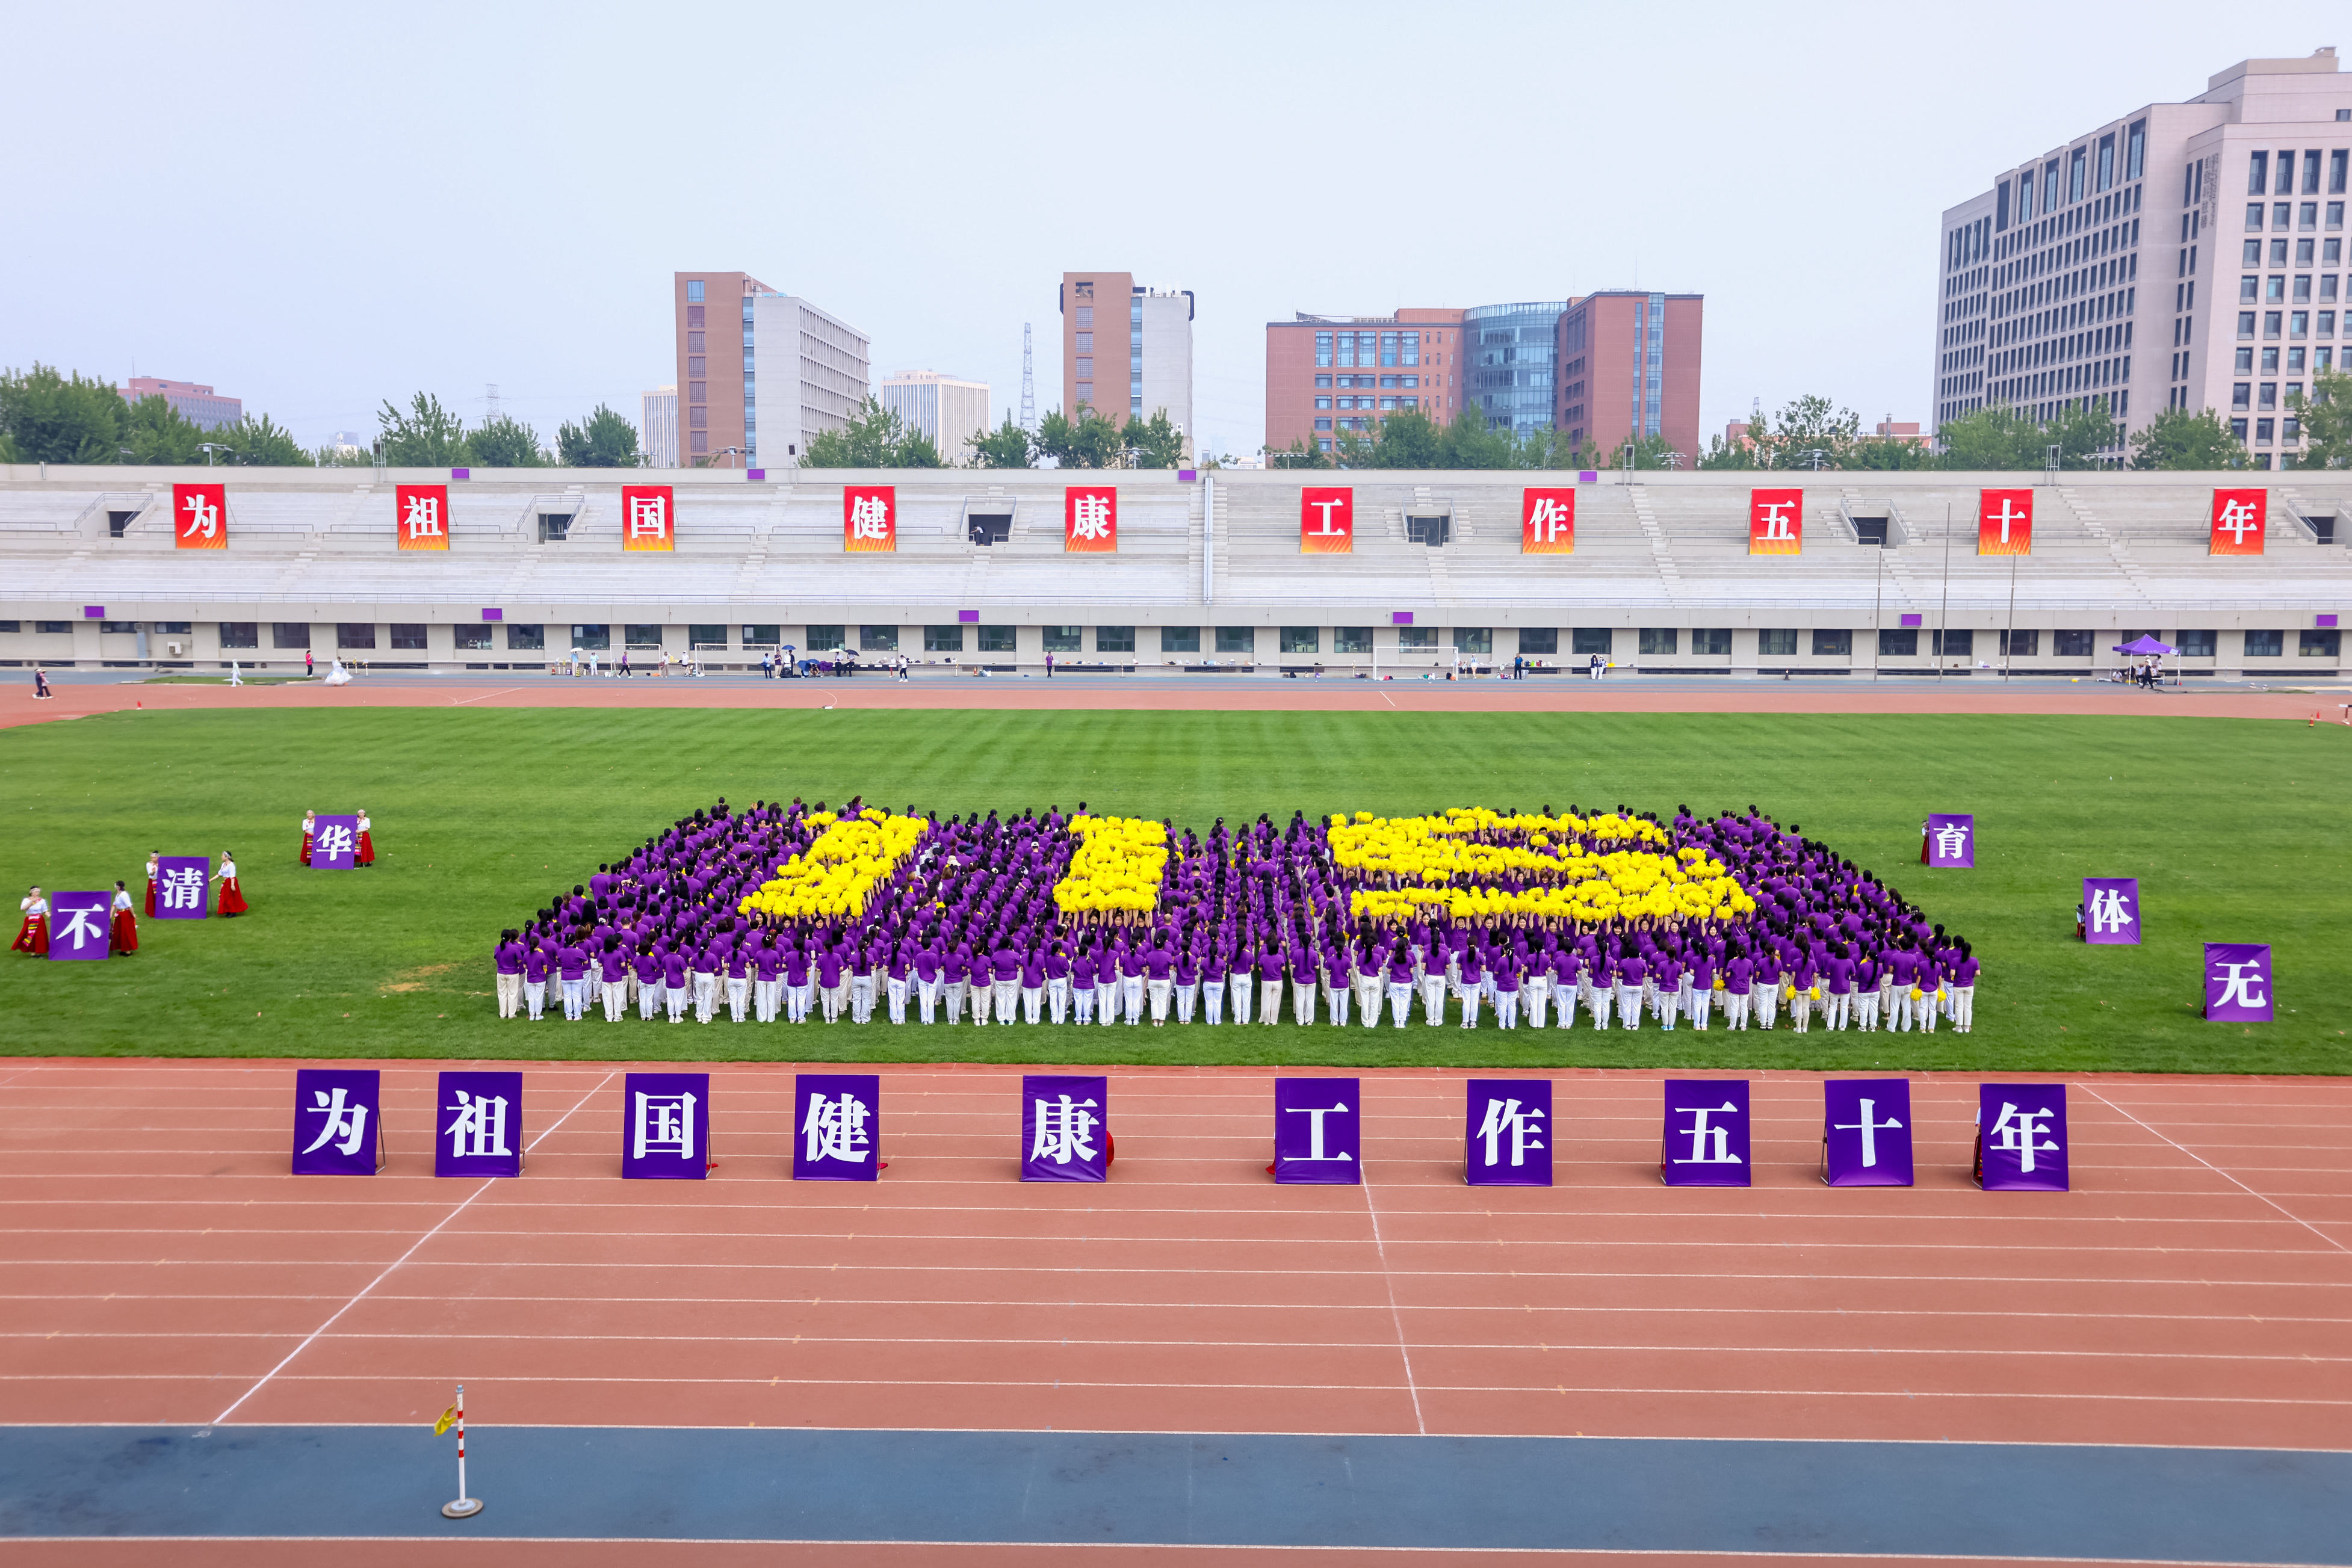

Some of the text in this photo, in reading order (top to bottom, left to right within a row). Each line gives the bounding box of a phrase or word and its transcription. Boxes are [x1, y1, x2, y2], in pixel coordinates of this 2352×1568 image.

[182, 494, 218, 539] 为
[403, 495, 443, 540] 祖
[630, 495, 666, 539] 国
[850, 496, 888, 540] 健
[1071, 495, 1111, 540] 康
[1307, 498, 1346, 536] 工
[1529, 498, 1568, 543] 作
[1756, 500, 1796, 540] 五
[1987, 499, 2026, 544] 十
[2217, 499, 2258, 545] 年
[316, 824, 352, 861] 华
[1933, 823, 1969, 859] 育
[162, 867, 203, 909] 清
[55, 903, 105, 950] 不
[2088, 889, 2134, 933] 体
[2212, 959, 2267, 1008] 无
[302, 1088, 368, 1156] 为
[444, 1090, 512, 1158] 祖
[633, 1091, 697, 1159] 国
[802, 1093, 871, 1162] 健
[1030, 1094, 1100, 1165] 康
[1283, 1102, 1353, 1161] 工
[1476, 1098, 1545, 1167] 作
[1673, 1101, 1742, 1164] 五
[1834, 1098, 1903, 1167] 十
[1990, 1102, 2060, 1173] 年
